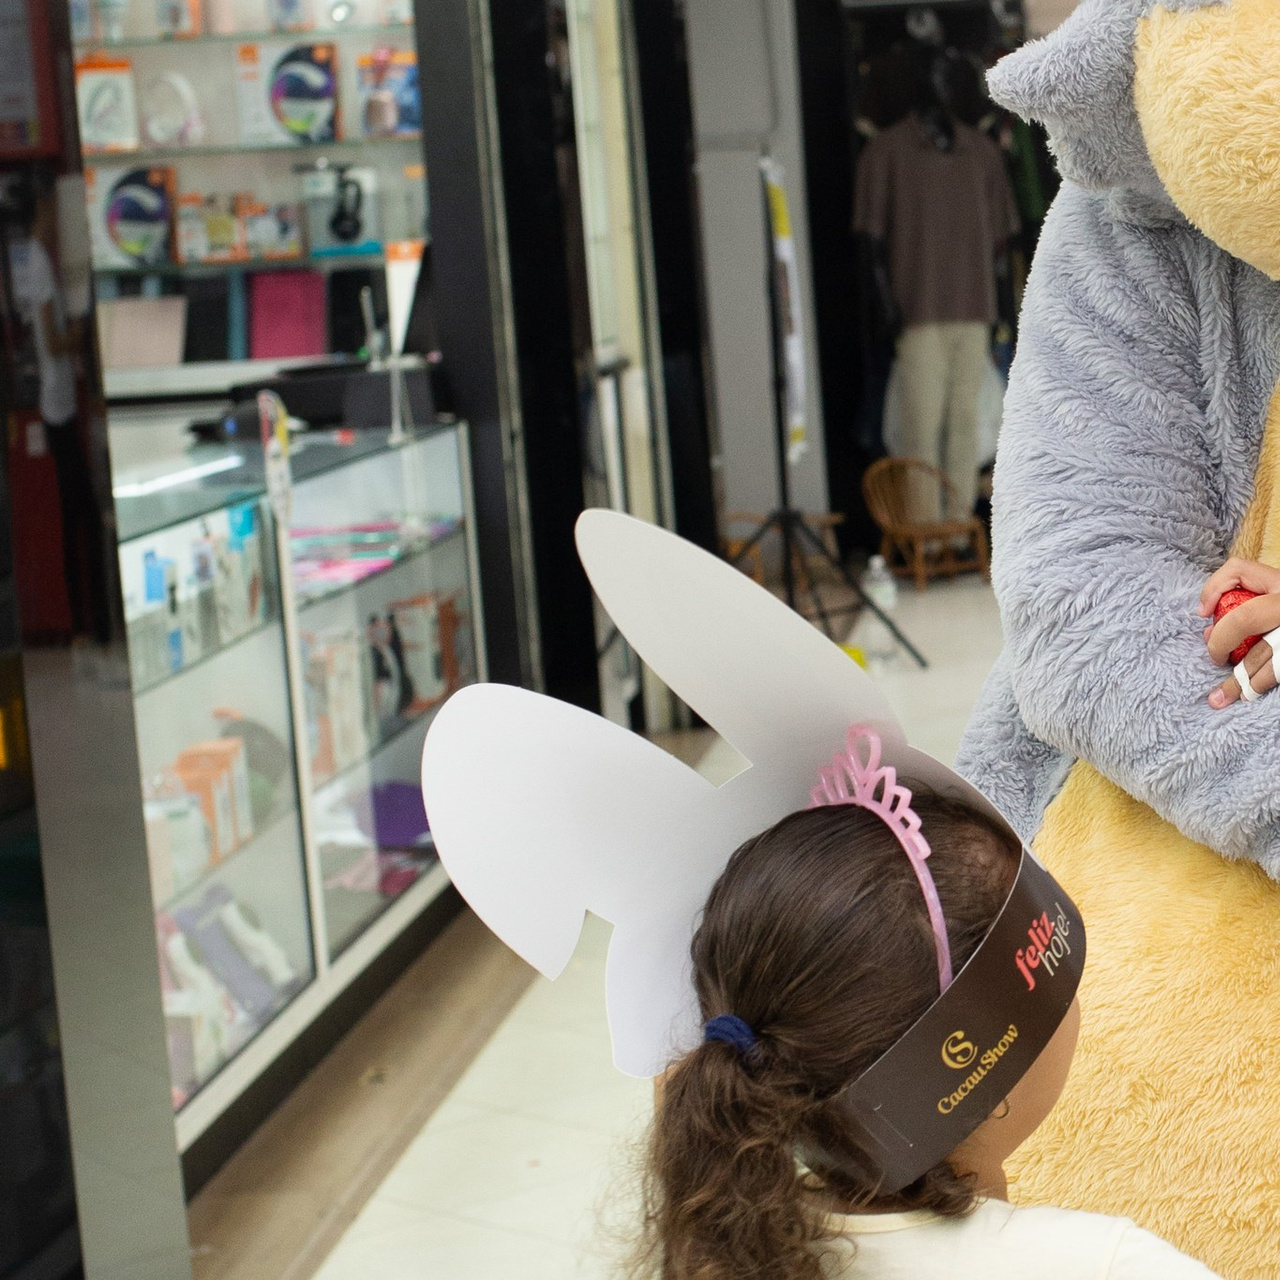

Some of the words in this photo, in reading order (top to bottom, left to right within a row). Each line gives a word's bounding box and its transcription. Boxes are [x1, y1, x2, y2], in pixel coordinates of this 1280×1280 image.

[1014, 910, 1055, 991] feliz
[1038, 901, 1070, 977] hoje!
[936, 1063, 988, 1115] Cacau
[980, 1023, 1020, 1071] Show
